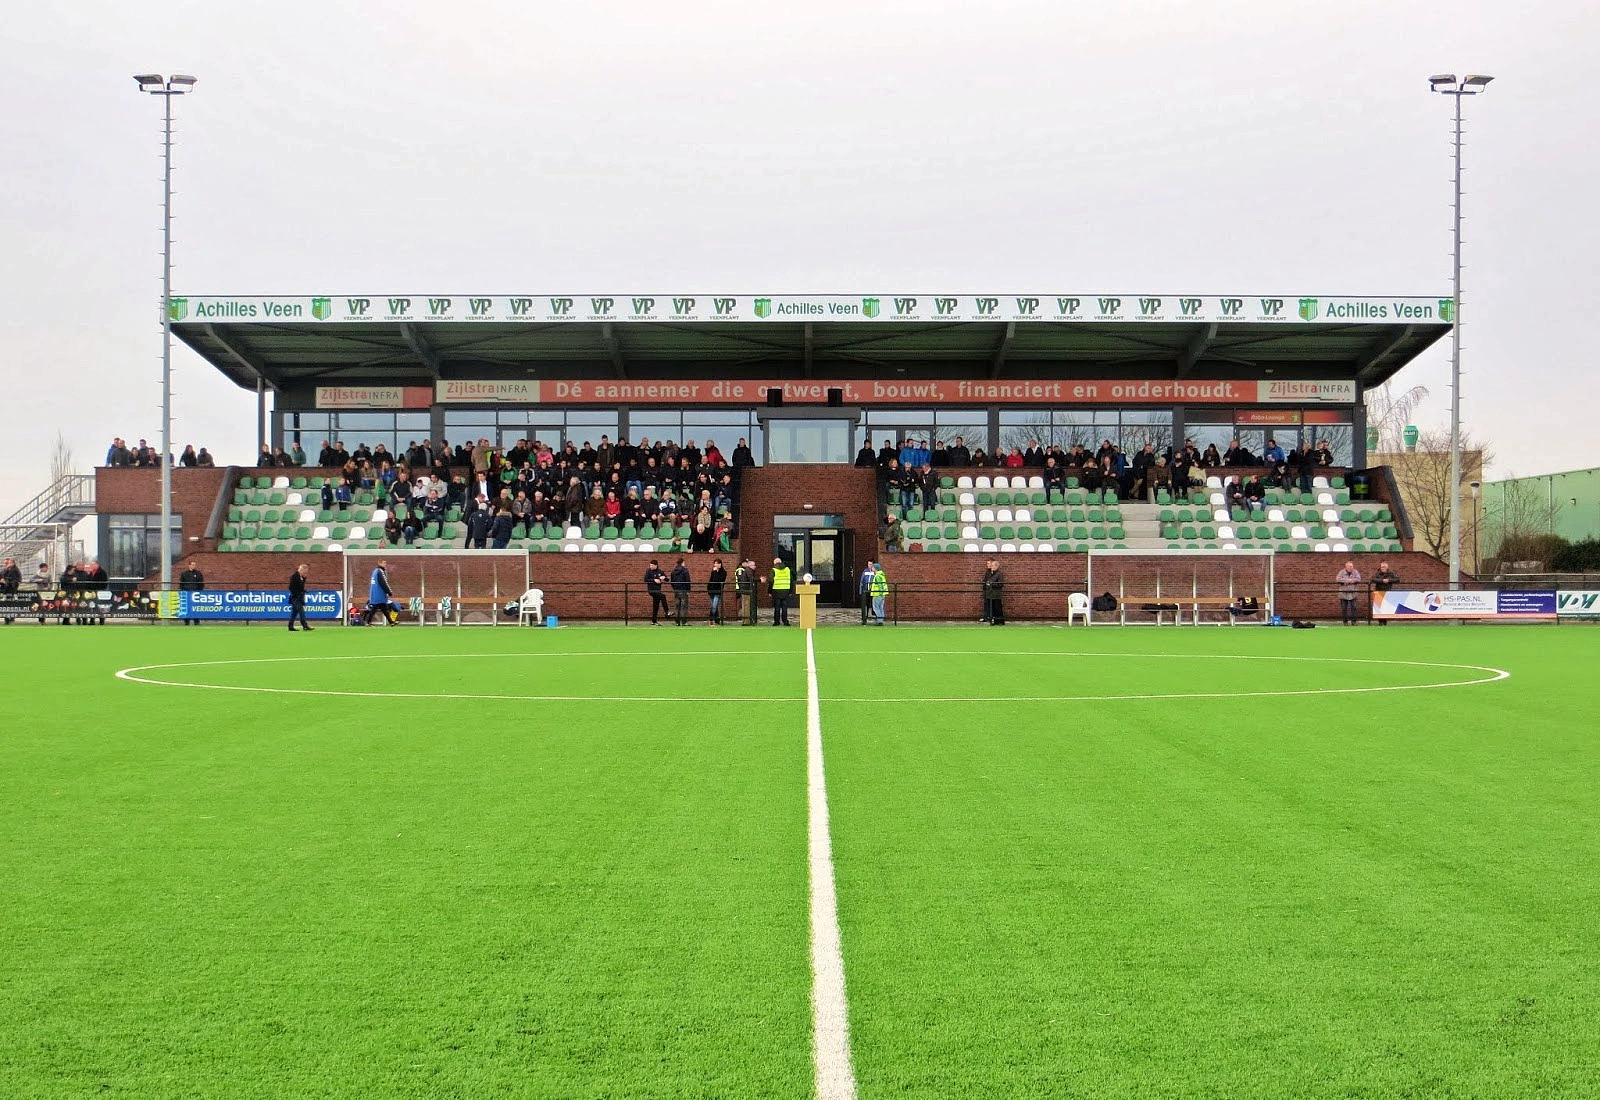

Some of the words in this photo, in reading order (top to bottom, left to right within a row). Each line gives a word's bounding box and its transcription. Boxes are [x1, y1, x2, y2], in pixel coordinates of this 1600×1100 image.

[195, 301, 258, 318] Achilles
[262, 301, 304, 317] Veen
[347, 298, 371, 315] VP
[387, 298, 411, 315] VP
[427, 298, 451, 315] VP
[468, 298, 492, 315] VP
[508, 298, 532, 315] VP
[549, 298, 573, 315] VP
[590, 298, 614, 315] VP
[631, 298, 655, 315] VP
[672, 298, 696, 315] VP
[713, 298, 737, 315] VP
[777, 301, 825, 316] Achilles
[828, 302, 860, 316] Veen
[893, 298, 917, 315] VP
[934, 298, 958, 315] VP
[975, 298, 999, 315] VP
[1015, 298, 1039, 315] VP
[1056, 298, 1080, 315] VP
[1097, 298, 1121, 315] VP
[1138, 298, 1162, 315] VP
[1178, 298, 1202, 315] VP
[1219, 298, 1243, 315] VP
[1260, 298, 1284, 315] VP
[1325, 301, 1388, 318] Achilles
[1392, 302, 1433, 318] Veen
[556, 381, 582, 398] Dé
[595, 384, 699, 398] aannemer
[711, 381, 745, 398] die
[757, 382, 860, 400] otwert,
[873, 381, 945, 400] bouwt,
[958, 381, 1061, 398] financiert
[1072, 384, 1097, 398] en
[1111, 381, 1240, 398] onderhoudt.
[192, 592, 222, 606] Easy
[225, 591, 286, 604] Container
[288, 591, 336, 604] rvice
[192, 605, 224, 613] VERKOOP
[225, 605, 231, 613] &
[232, 605, 266, 613] VERHUUR
[267, 605, 282, 613] VAN
